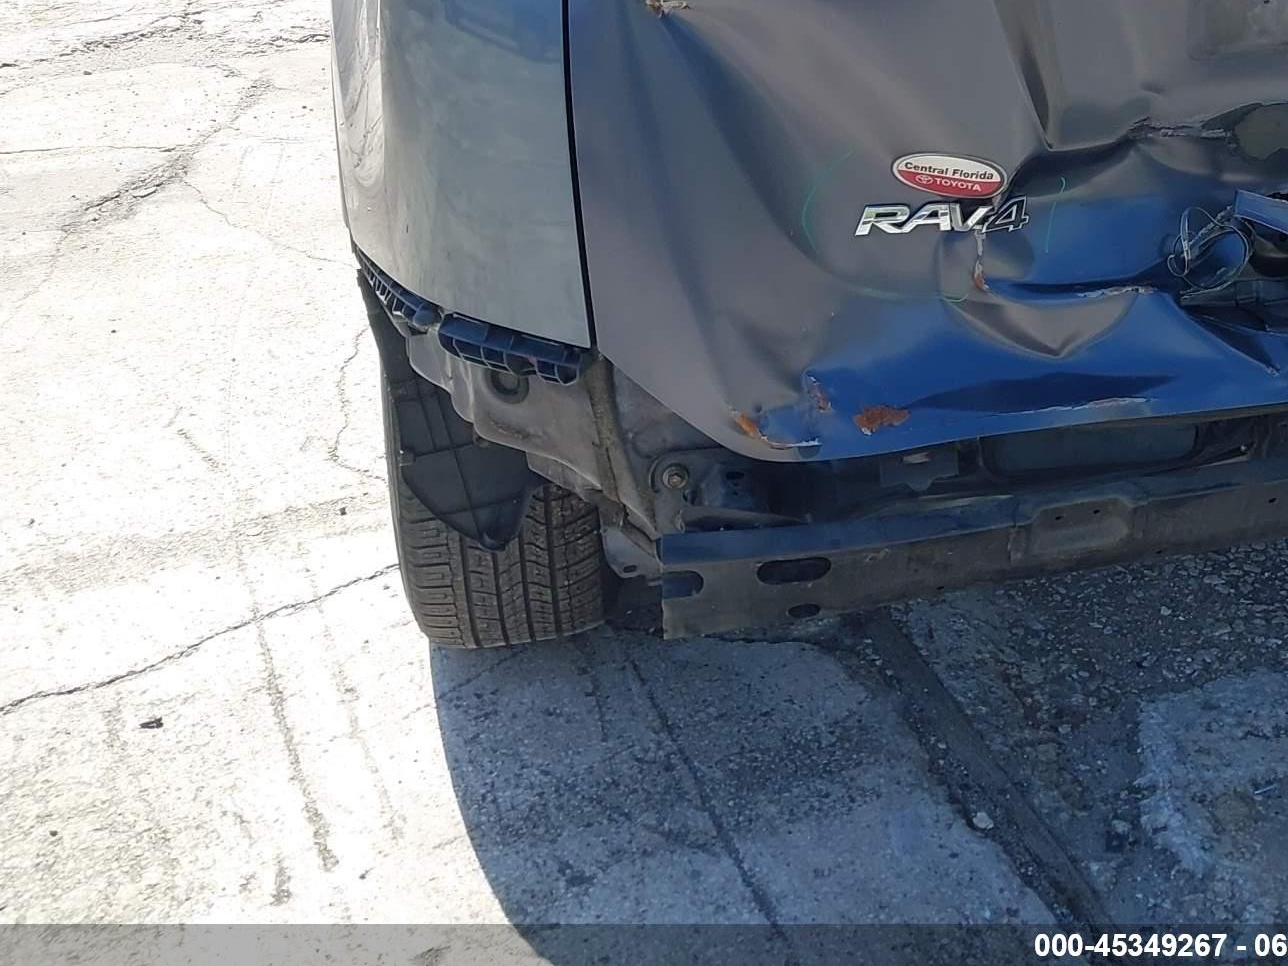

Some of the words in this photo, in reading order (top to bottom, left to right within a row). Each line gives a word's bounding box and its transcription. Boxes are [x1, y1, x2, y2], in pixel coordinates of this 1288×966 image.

[904, 161, 949, 176] Central
[951, 168, 994, 181] Florida
[934, 177, 982, 192] TOYOTA
[855, 195, 1030, 237] RAV4
